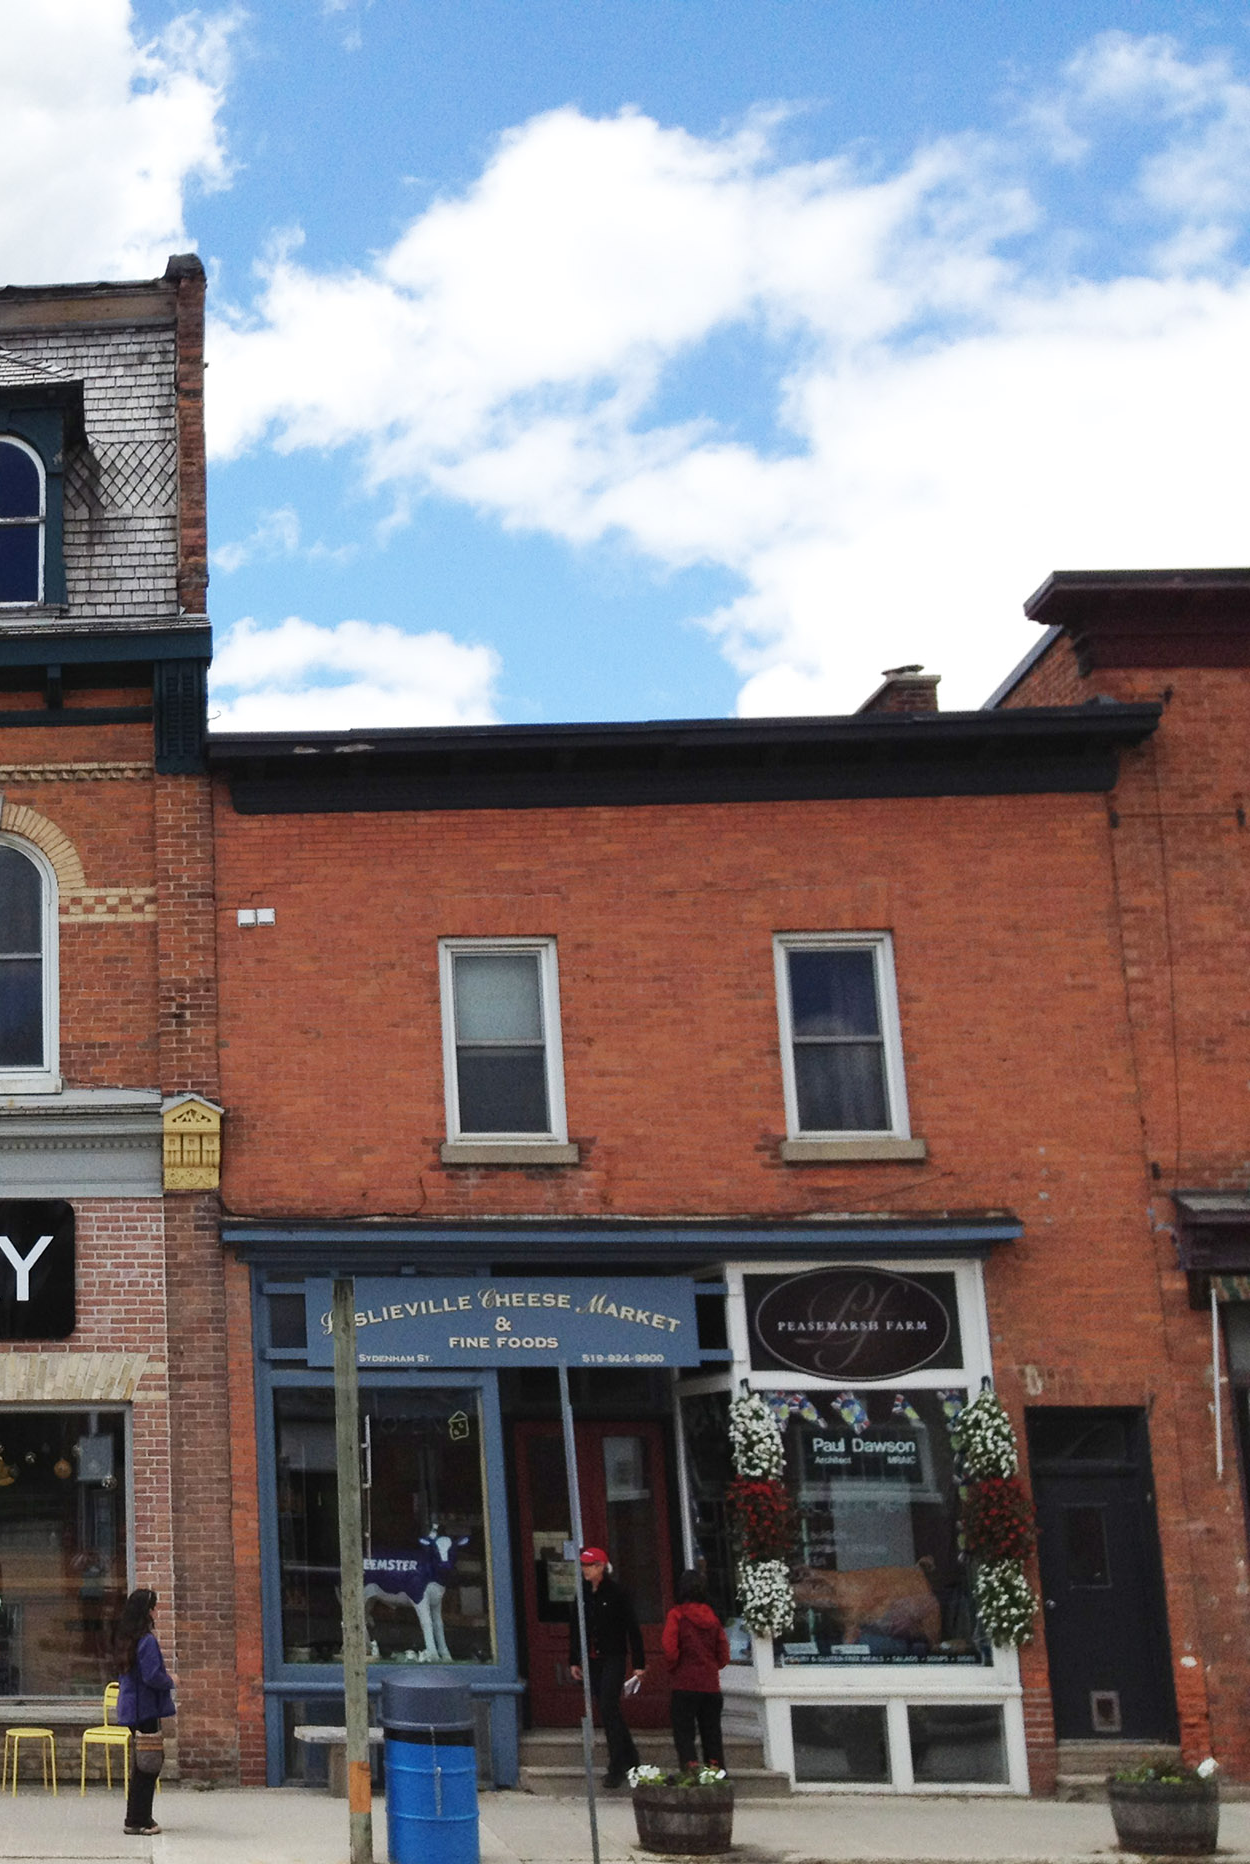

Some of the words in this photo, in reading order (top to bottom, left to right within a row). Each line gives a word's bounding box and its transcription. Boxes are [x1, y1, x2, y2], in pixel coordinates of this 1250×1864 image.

[477, 1287, 571, 1310] CHEESE
[575, 1294, 681, 1334] MARKET
[494, 1316, 512, 1332] &
[777, 1321, 879, 1331] PEASEMARSH
[886, 1321, 928, 1330] FARM
[449, 1336, 490, 1349] FINE
[497, 1336, 559, 1349] FOODS
[358, 1353, 415, 1363] SYDENHAM
[812, 1437, 845, 1452] Paul
[852, 1438, 916, 1453] Dawson
[363, 1559, 418, 1571] EEMSTER
